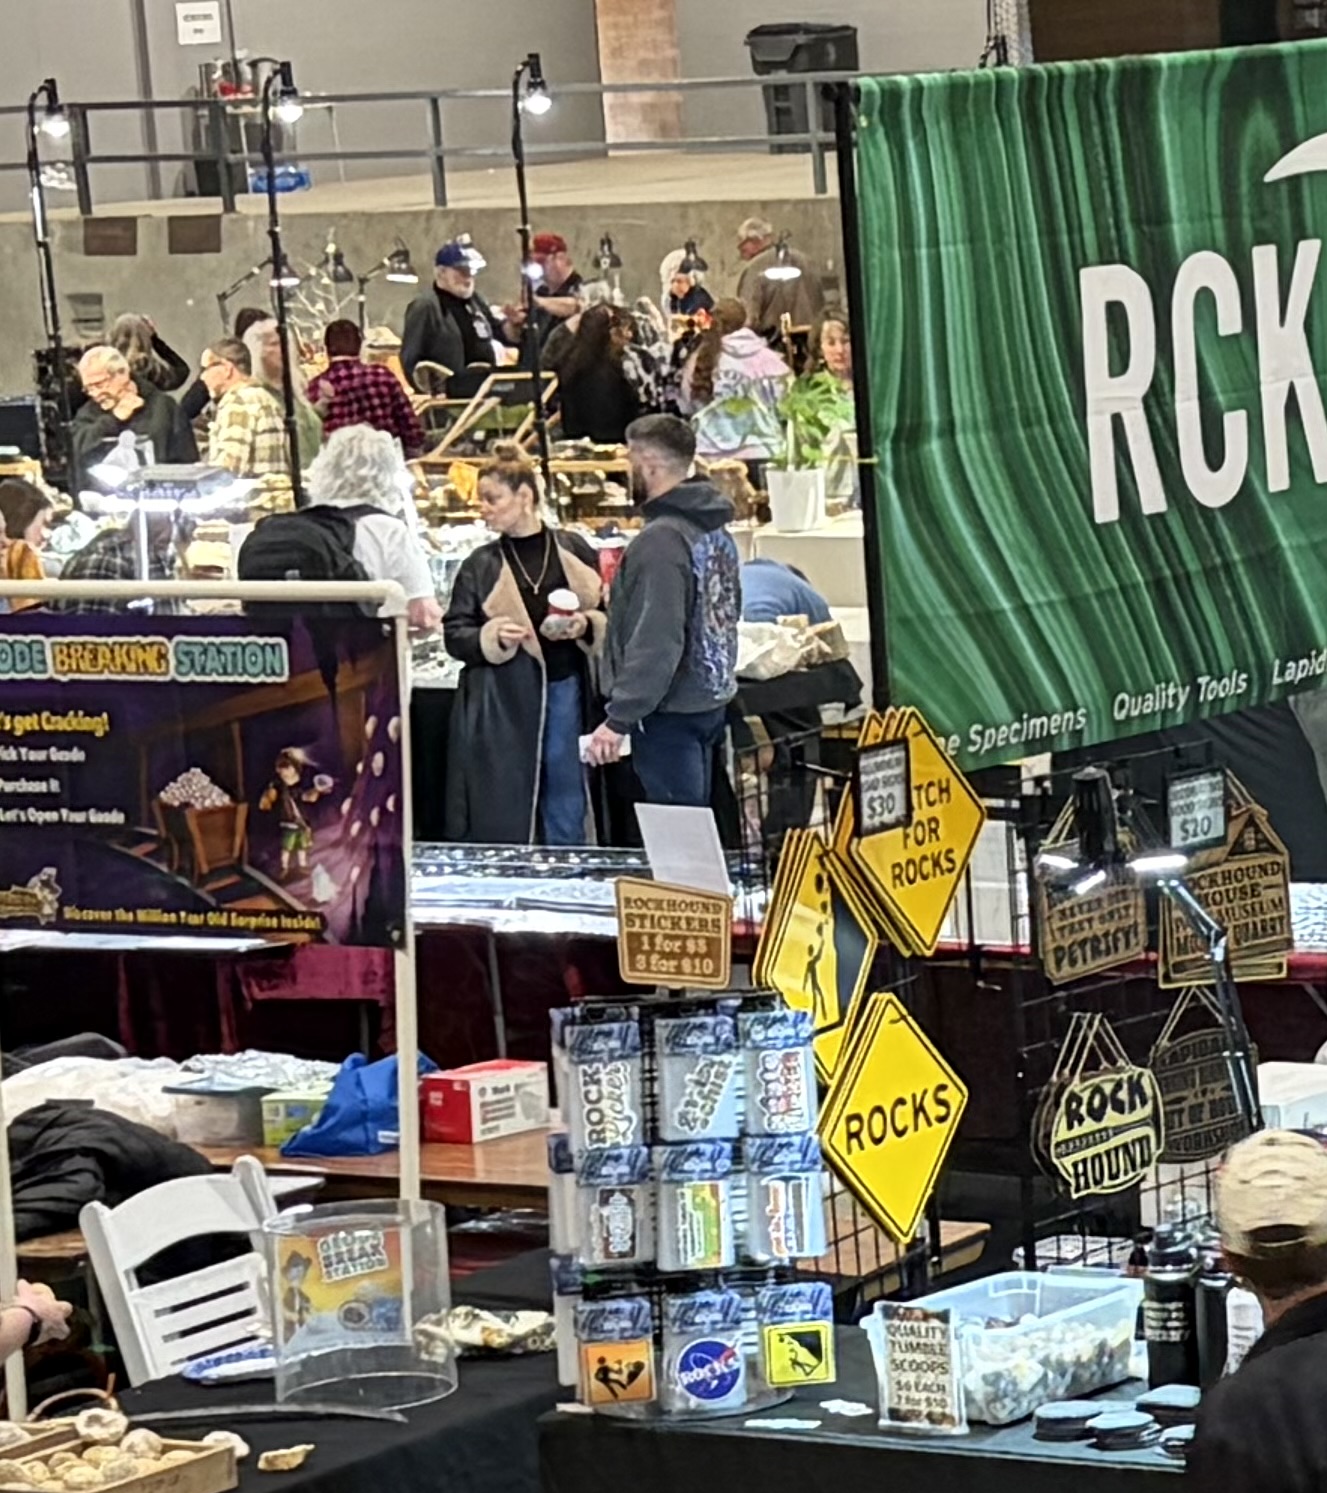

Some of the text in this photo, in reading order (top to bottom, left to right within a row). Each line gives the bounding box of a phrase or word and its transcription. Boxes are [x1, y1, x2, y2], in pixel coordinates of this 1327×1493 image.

[51, 641, 170, 676] BREAKING
[174, 640, 285, 677] STATION
[13, 713, 40, 736] get
[41, 710, 110, 737] Cracking!
[967, 706, 1087, 753] Specimens
[1113, 681, 1190, 721] Quality
[1198, 669, 1249, 704] Tools
[866, 792, 896, 820] $30
[913, 777, 952, 810] TCH
[903, 816, 941, 849] FOR
[890, 848, 957, 889] ROCKS
[1189, 861, 1282, 891] OCKHOUND
[623, 896, 722, 915] ROCKHOUND
[624, 912, 722, 934] STICKERS
[641, 934, 651, 951] 1
[654, 933, 682, 953] for
[1053, 922, 1140, 974] PETRIFY!
[650, 953, 679, 972] for
[681, 957, 714, 975] $10
[580, 1064, 607, 1146] ROCK
[1064, 1071, 1149, 1132] ROCK
[844, 1080, 953, 1156] ROCKS
[1071, 1134, 1151, 1194] HOUND
[887, 1323, 947, 1339] QUALITY
[889, 1340, 946, 1356] TUMBLE
[890, 1359, 949, 1375] SCOOPS
[914, 1381, 946, 1393] EACH
